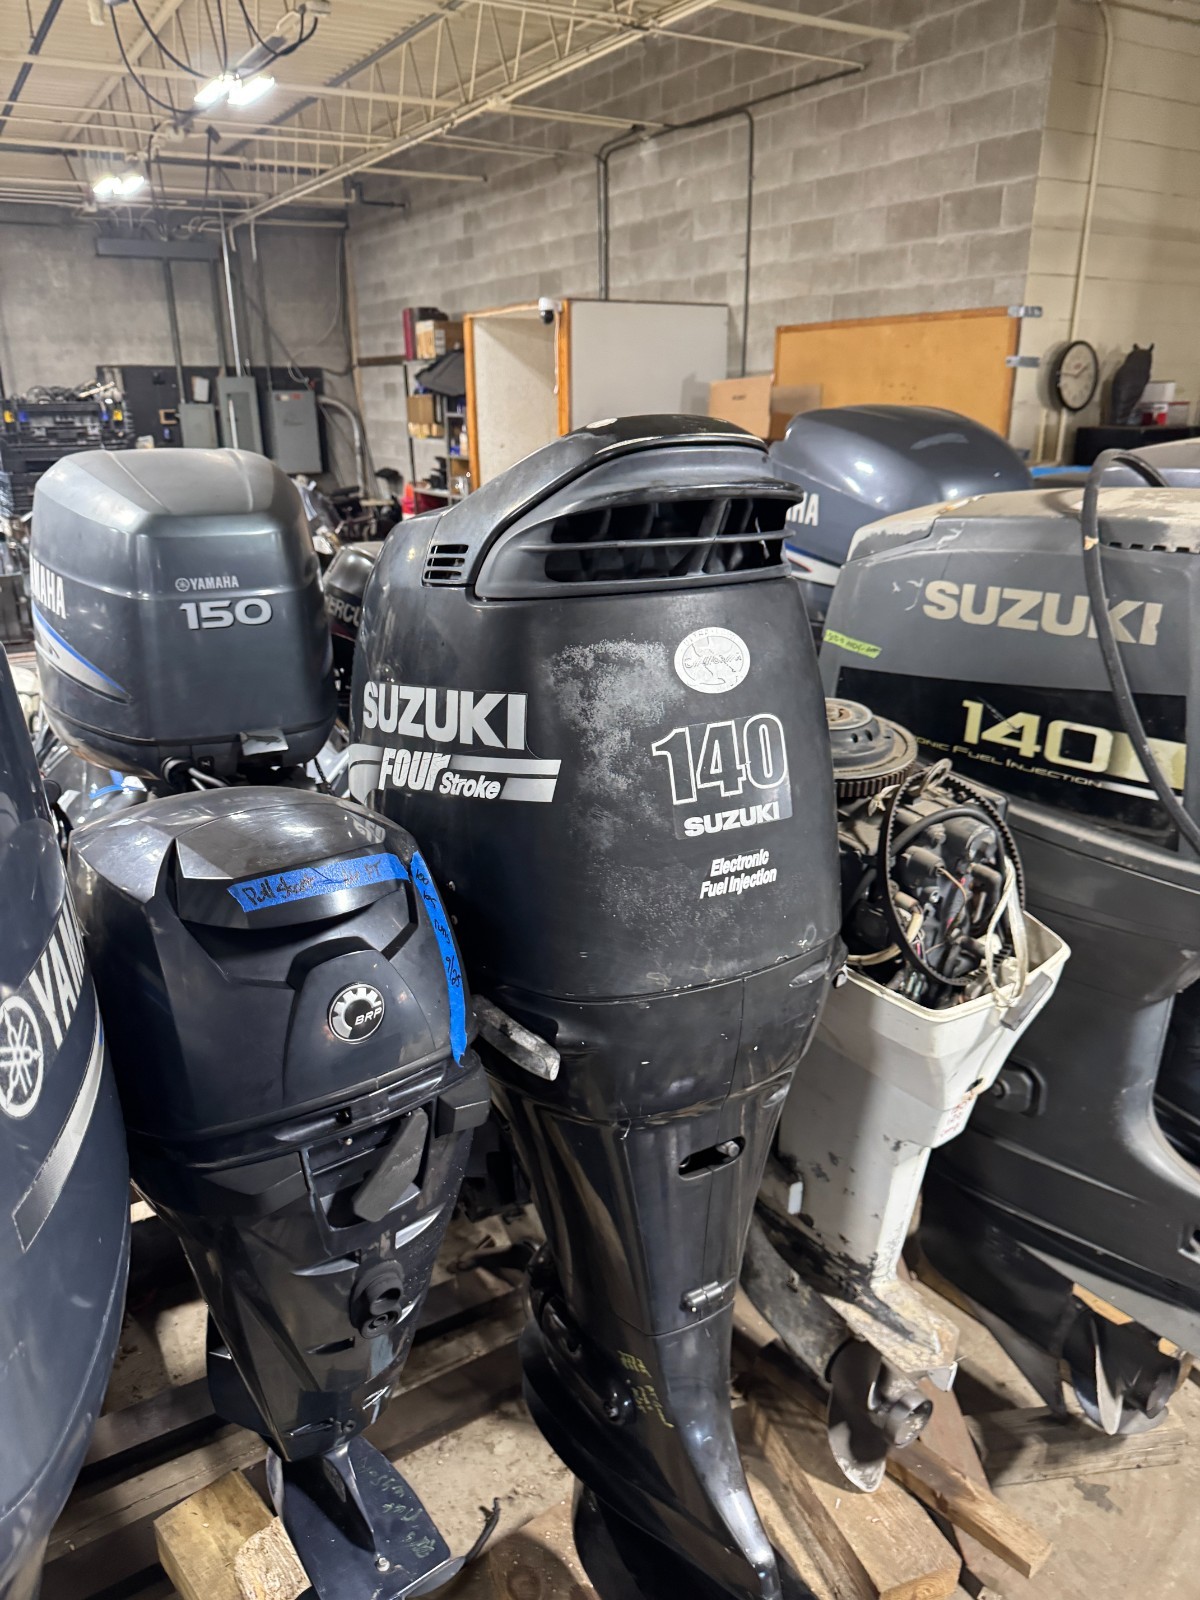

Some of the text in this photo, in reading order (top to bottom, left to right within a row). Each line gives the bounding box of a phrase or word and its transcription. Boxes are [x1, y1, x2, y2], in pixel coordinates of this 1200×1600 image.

[189, 575, 240, 591] YAMAHA
[179, 597, 273, 630] 150
[922, 580, 1164, 646] SUZUKI
[362, 680, 527, 751] SUZUKI
[961, 699, 1113, 773] 140
[651, 713, 788, 806] 140
[952, 745, 1003, 766] FUEL
[1005, 758, 1102, 788] INJECTION
[439, 771, 501, 800] Stroke
[684, 801, 780, 837] SUZUKI
[710, 849, 770, 877] Electronic
[700, 867, 778, 900] Fuel Injection
[354, 1006, 382, 1026] BRP
